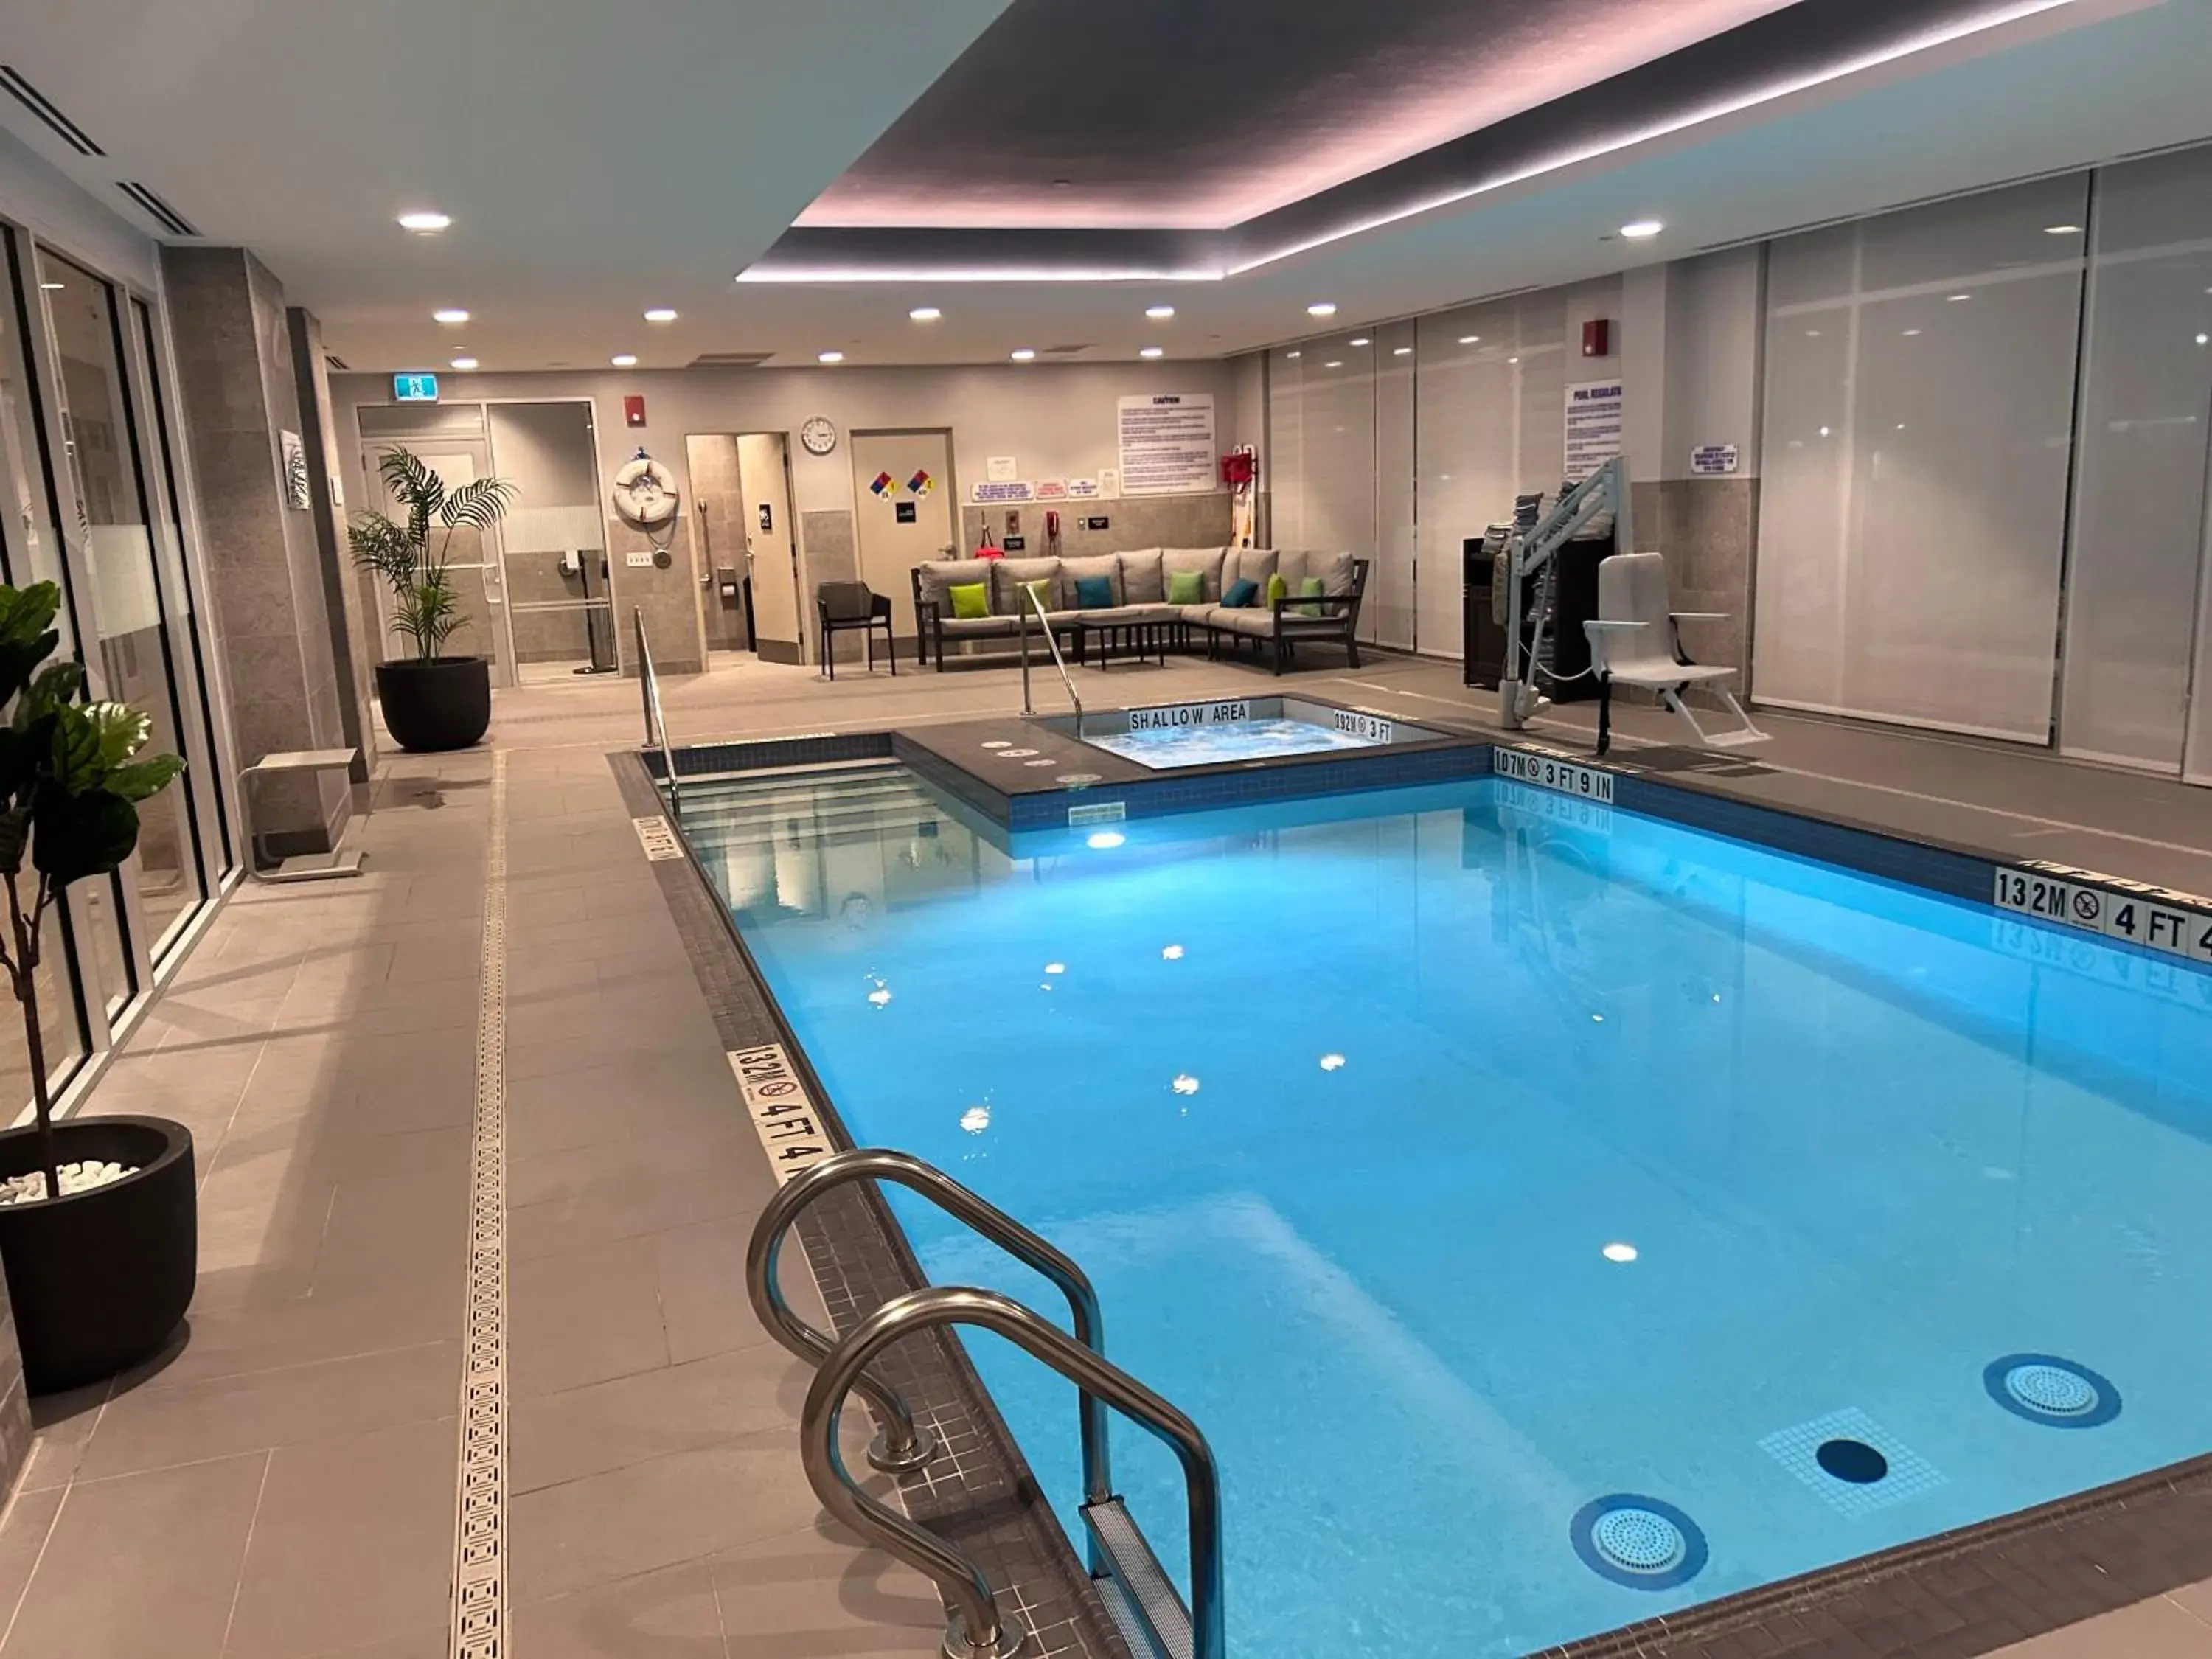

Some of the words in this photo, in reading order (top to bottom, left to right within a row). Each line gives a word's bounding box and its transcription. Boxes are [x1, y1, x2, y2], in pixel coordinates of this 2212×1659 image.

[1131, 707, 1203, 729] SHALLOW
[1213, 703, 1246, 722] AREA
[1370, 720, 1377, 738] 3
[1380, 723, 1390, 741] FT
[1545, 764, 1555, 784] 3
[1559, 768, 1574, 790] FT
[1580, 772, 1590, 793] 9
[1596, 776, 1610, 799] IN
[2115, 904, 2135, 936] 4
[2149, 910, 2185, 947] FT
[761, 1105, 803, 1117] 4
[765, 1117, 815, 1139] FT
[778, 1147, 824, 1160] 4
